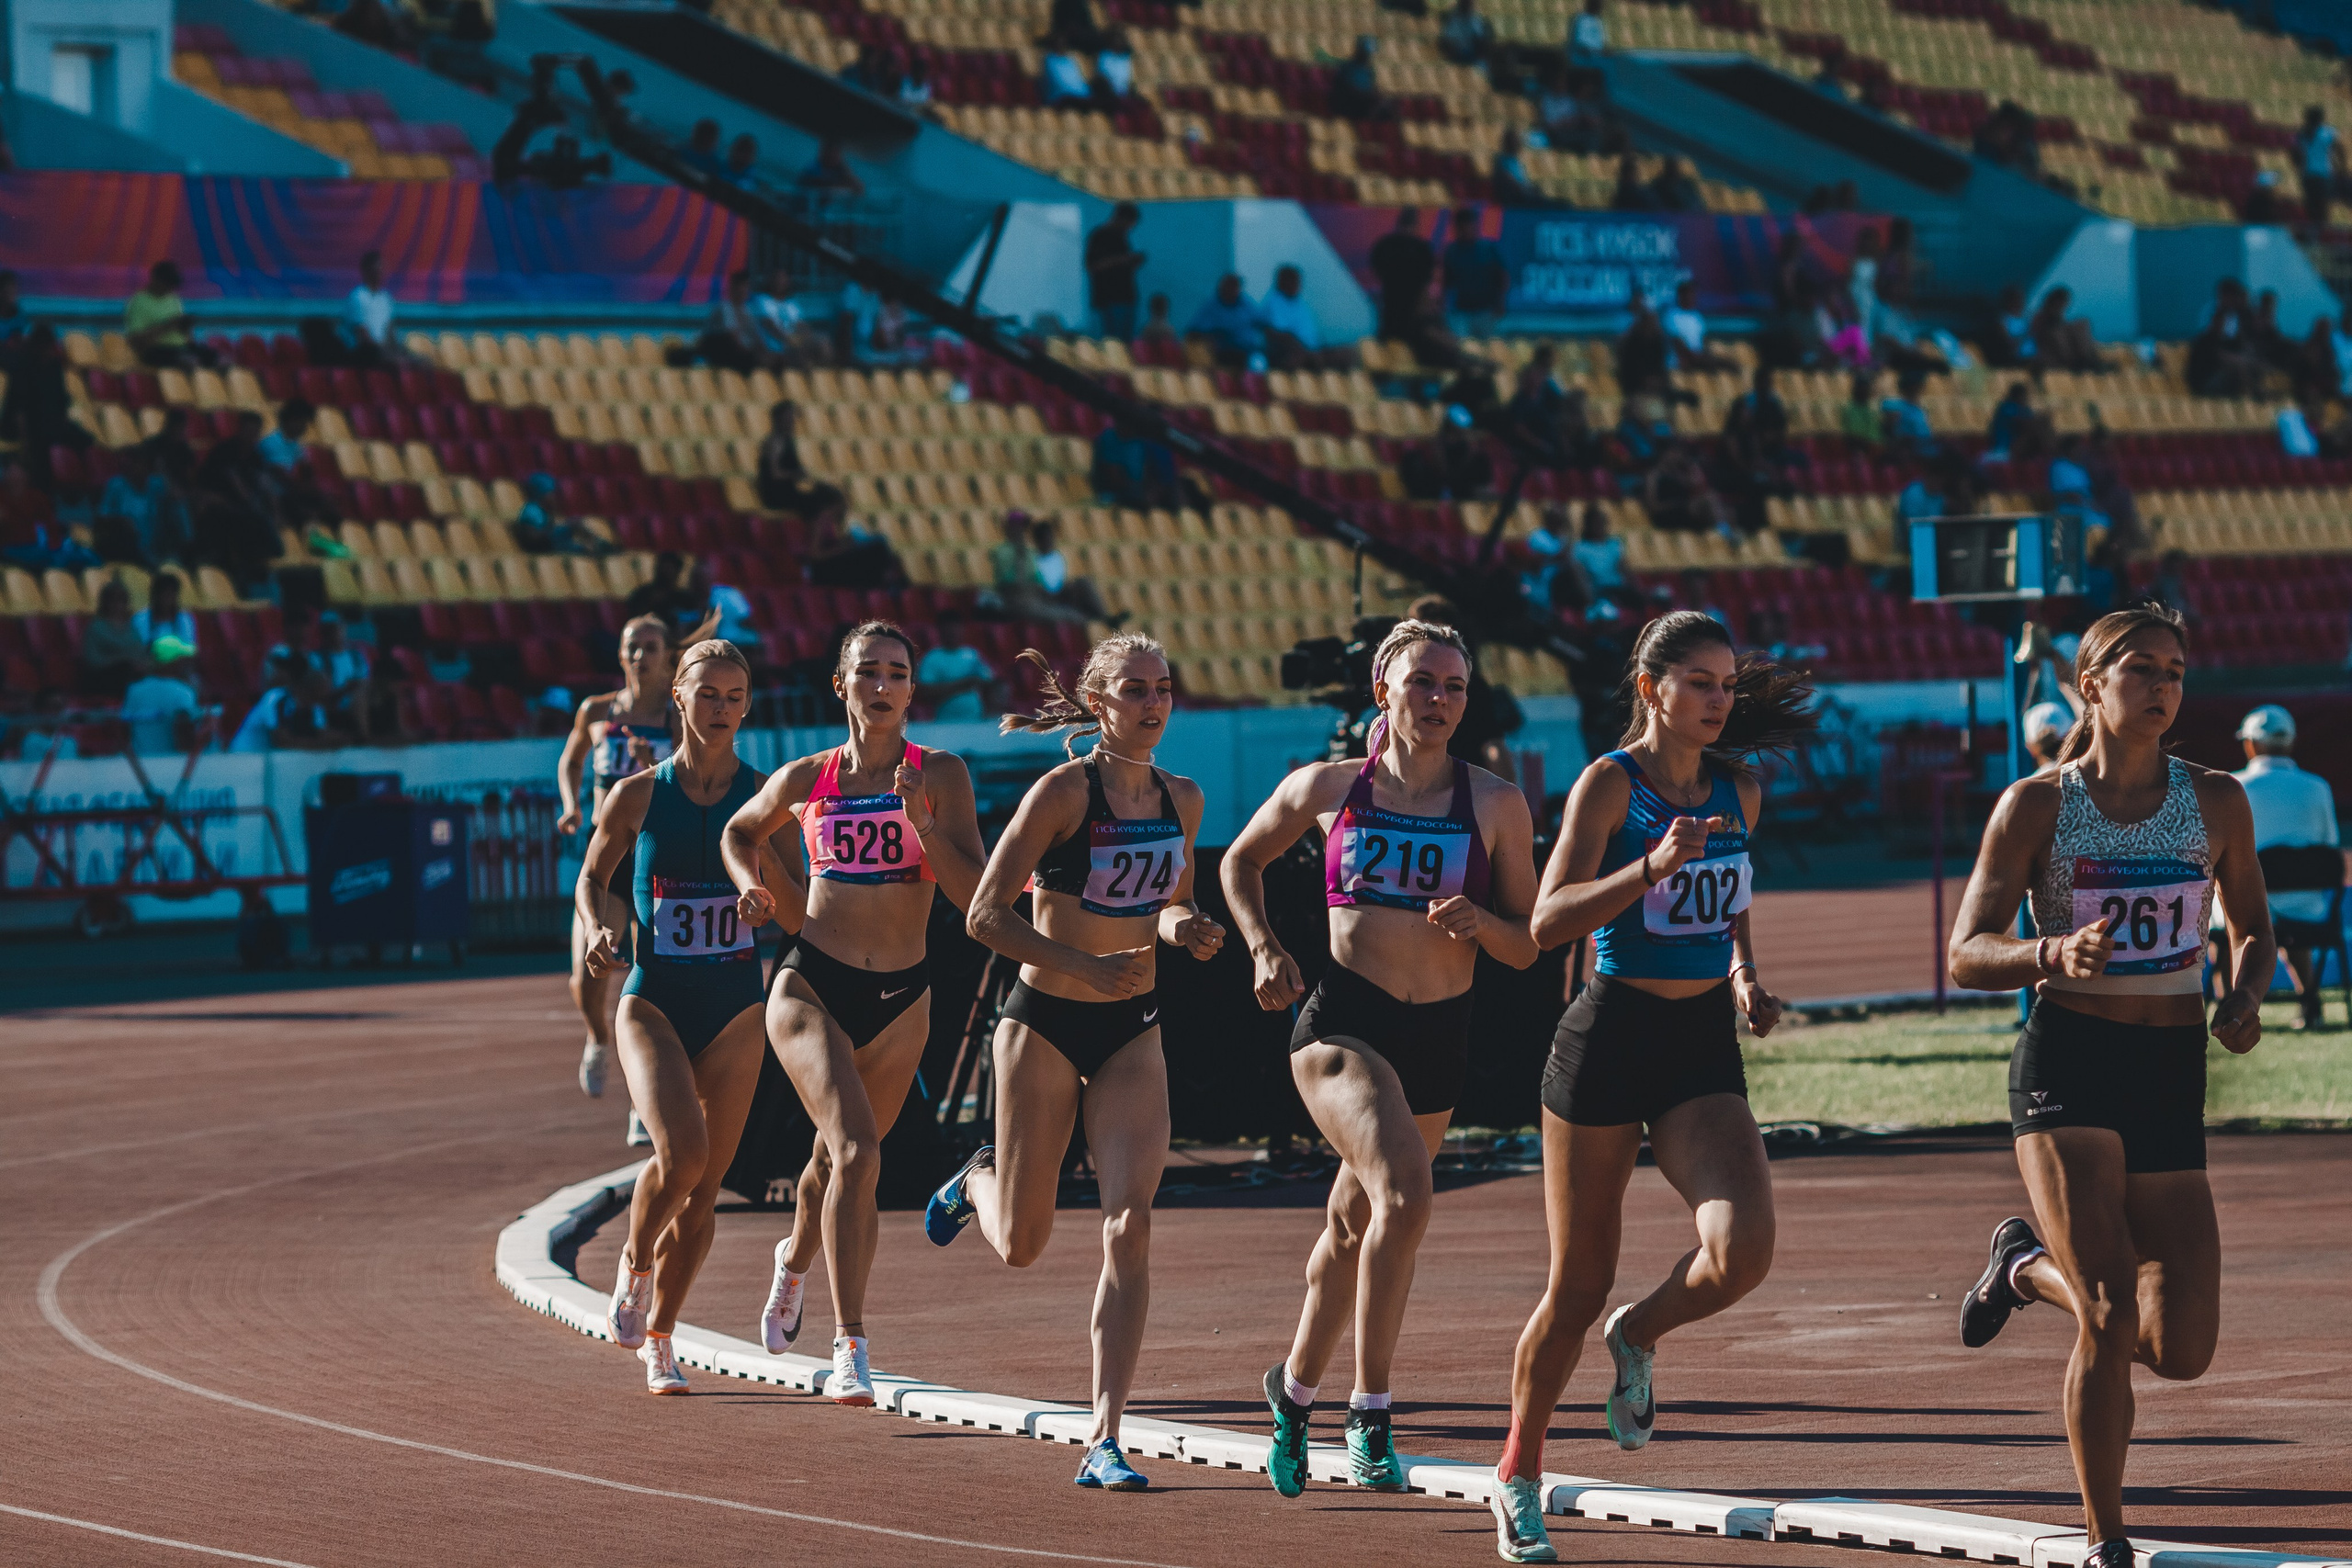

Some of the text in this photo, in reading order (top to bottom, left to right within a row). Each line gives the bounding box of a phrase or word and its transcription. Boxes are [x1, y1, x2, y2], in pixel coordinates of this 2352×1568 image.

[1095, 824, 1178, 834] ПСБ КУБОК РОССИИ
[1351, 807, 1463, 830] ПСБ КУБОК РОССИИ
[833, 820, 904, 865] 528
[1362, 834, 1444, 892] 219
[1708, 840, 1744, 849] РОССИИ
[658, 879, 677, 888] ПСБ
[679, 881, 711, 889] КУБОК
[1105, 851, 1172, 898] 274
[2081, 864, 2199, 876] ПСБ КУБОК РОССИИ
[1668, 868, 1739, 925] 202
[672, 903, 738, 948] 310
[2100, 895, 2184, 952] 261
